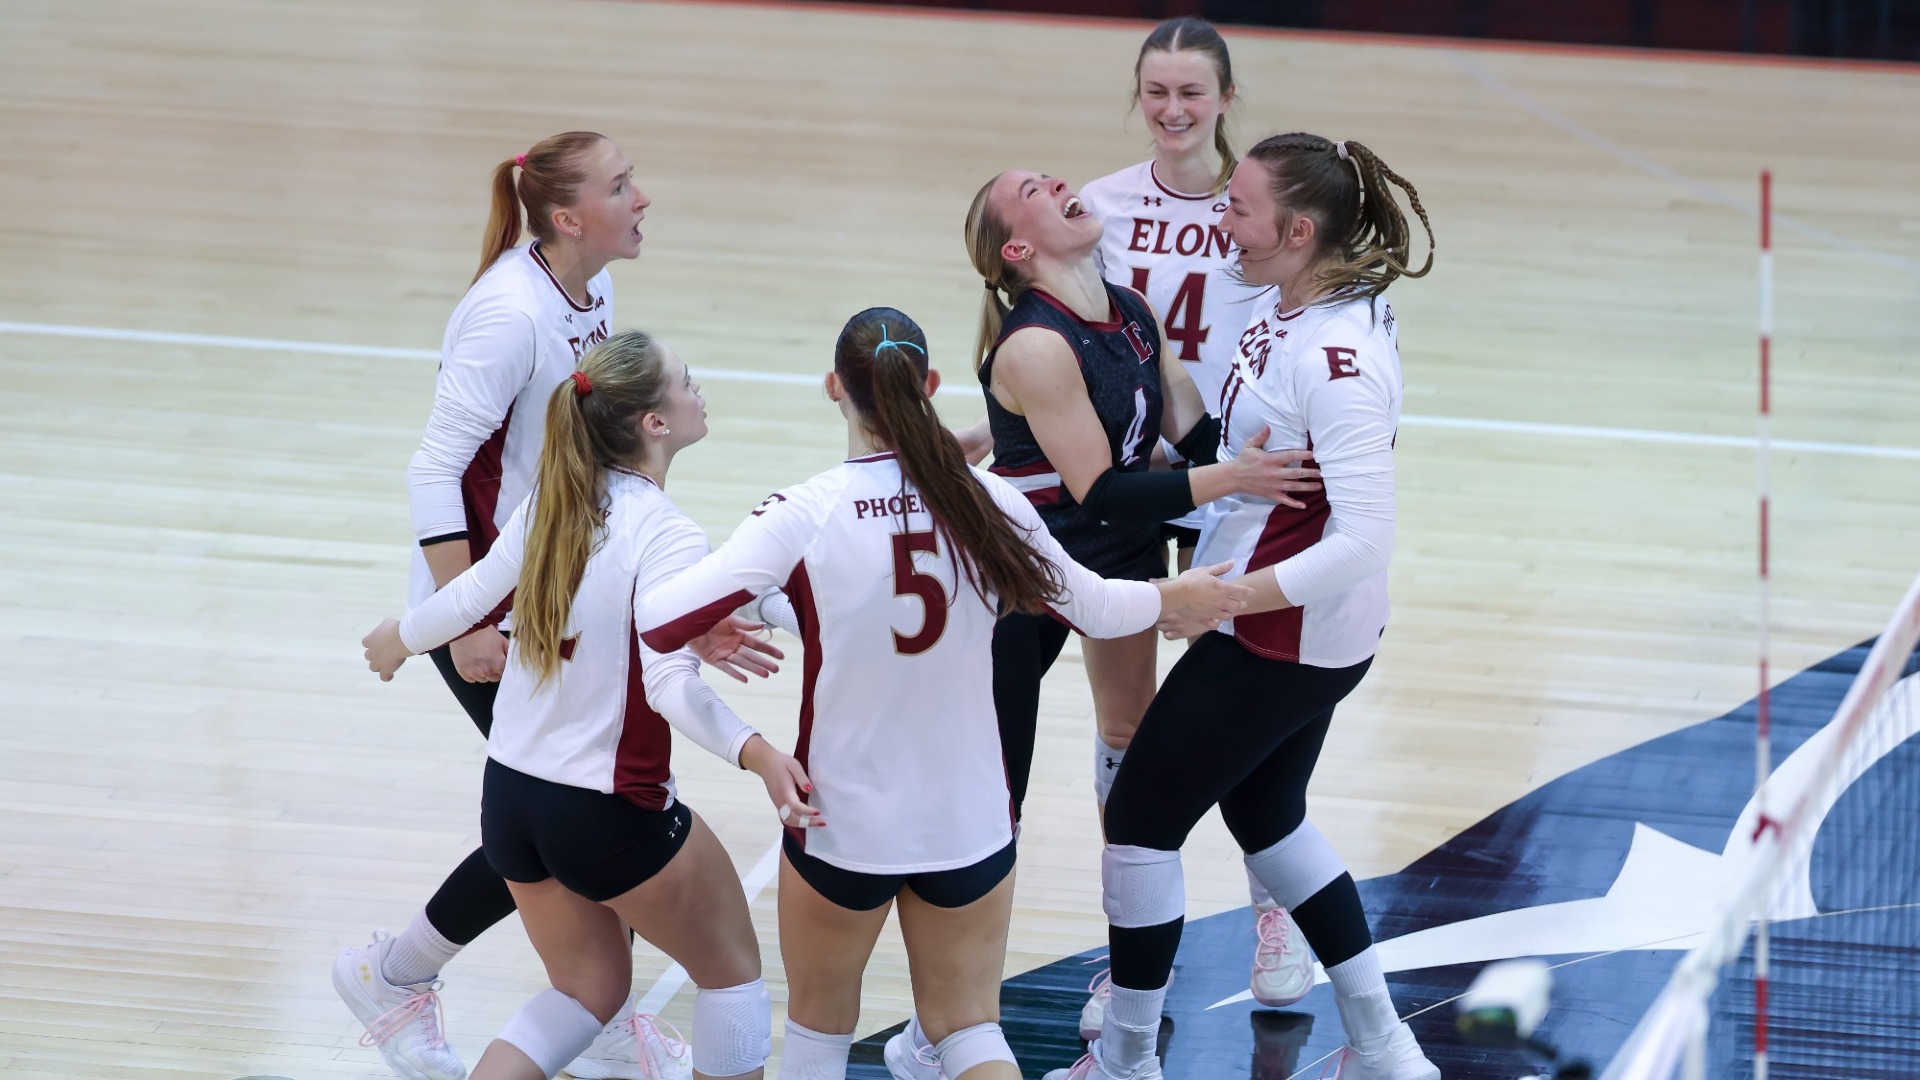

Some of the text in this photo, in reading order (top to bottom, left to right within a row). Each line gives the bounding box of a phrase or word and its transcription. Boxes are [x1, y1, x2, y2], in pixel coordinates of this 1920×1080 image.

[1128, 217, 1232, 259] ELON
[1321, 347, 1361, 382] E
[1119, 385, 1148, 467] 4
[889, 529, 950, 656] 5
